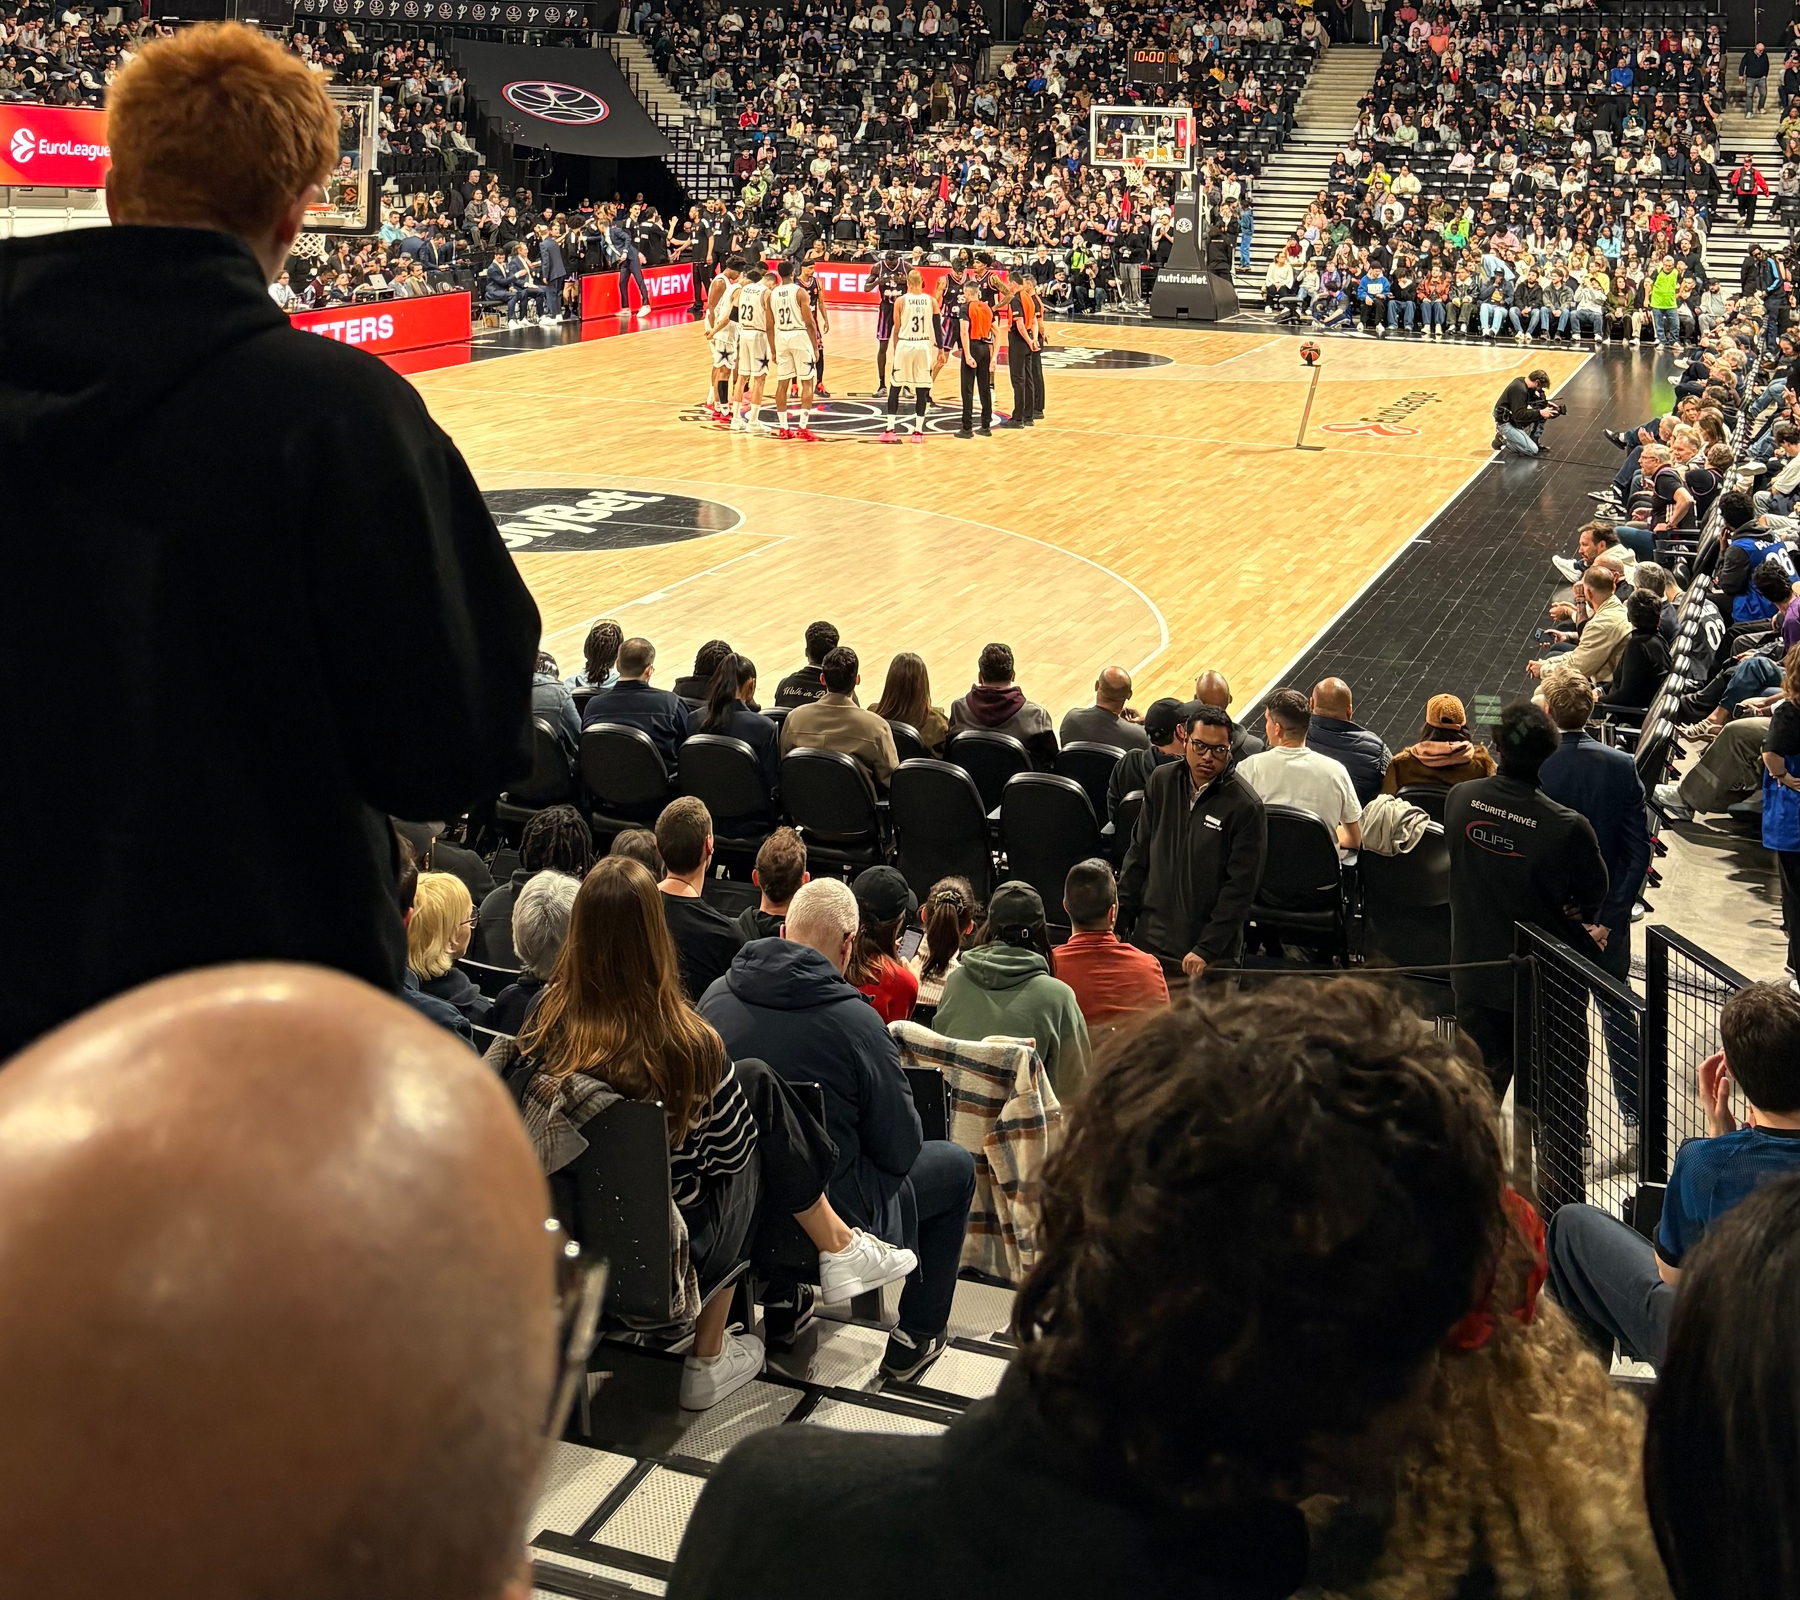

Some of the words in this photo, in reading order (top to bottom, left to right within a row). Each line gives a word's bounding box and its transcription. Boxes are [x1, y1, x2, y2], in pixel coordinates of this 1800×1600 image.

[1133, 50, 1165, 63] 10:00
[39, 139, 110, 161] EuroLeague
[741, 303, 754, 322] 23
[779, 307, 792, 325] 32
[911, 316, 925, 334] 31
[783, 686, 802, 696] Walk
[803, 689, 813, 697] in
[1470, 799, 1507, 819] SÉCURITÉ
[1507, 812, 1538, 828] PRIVÉE
